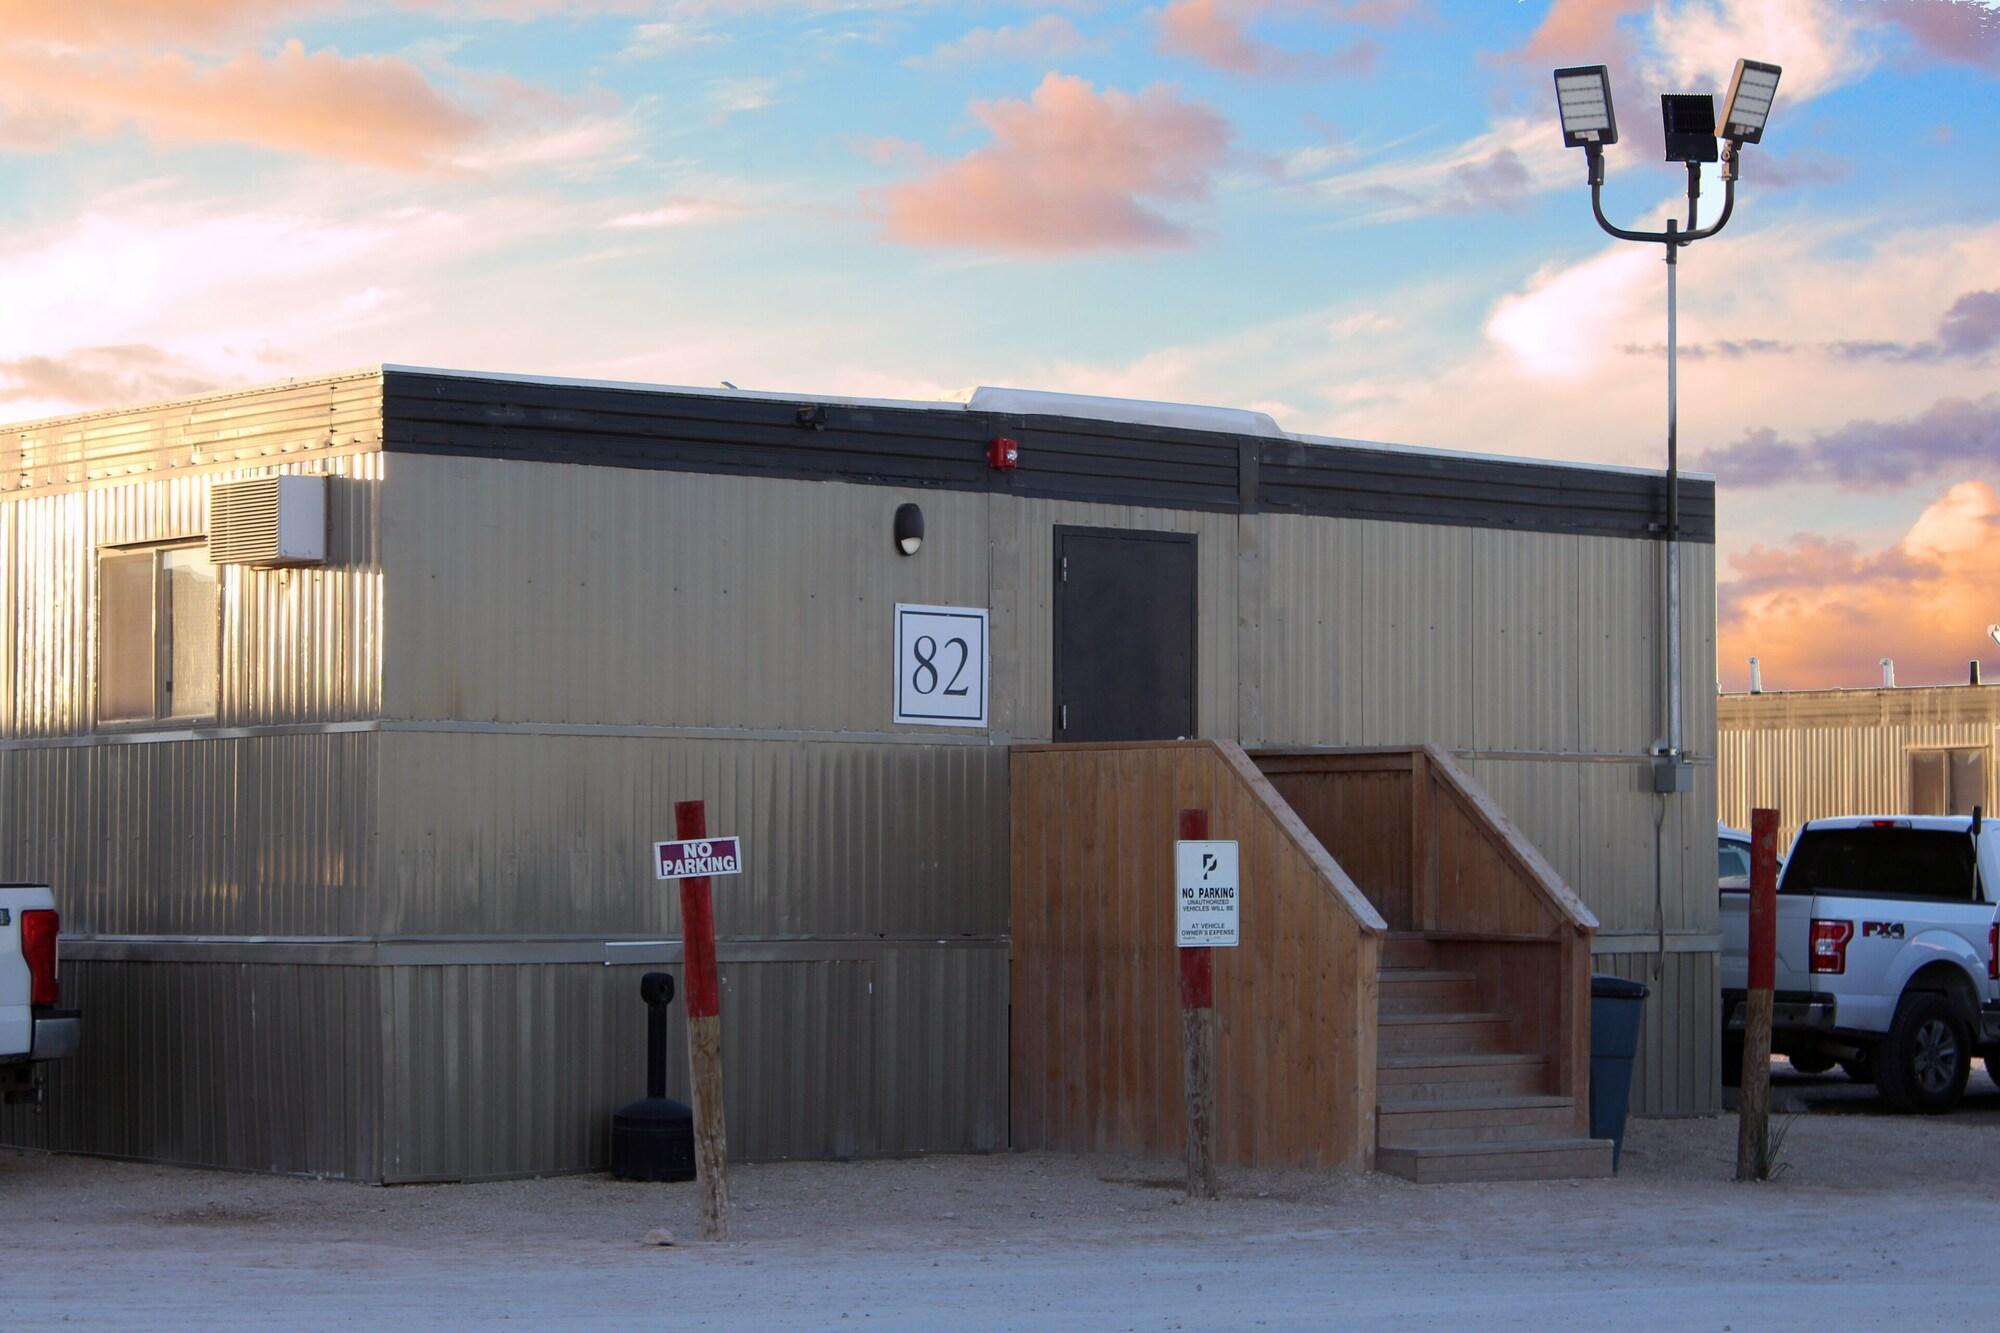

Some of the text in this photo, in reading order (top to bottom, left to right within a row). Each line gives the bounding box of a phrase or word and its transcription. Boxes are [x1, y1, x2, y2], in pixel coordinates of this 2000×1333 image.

[912, 635, 969, 696] 82
[683, 842, 713, 859] NO
[662, 855, 735, 876] PARKING
[1182, 888, 1234, 899] NO PARKING
[1862, 921, 1905, 937] FX4
